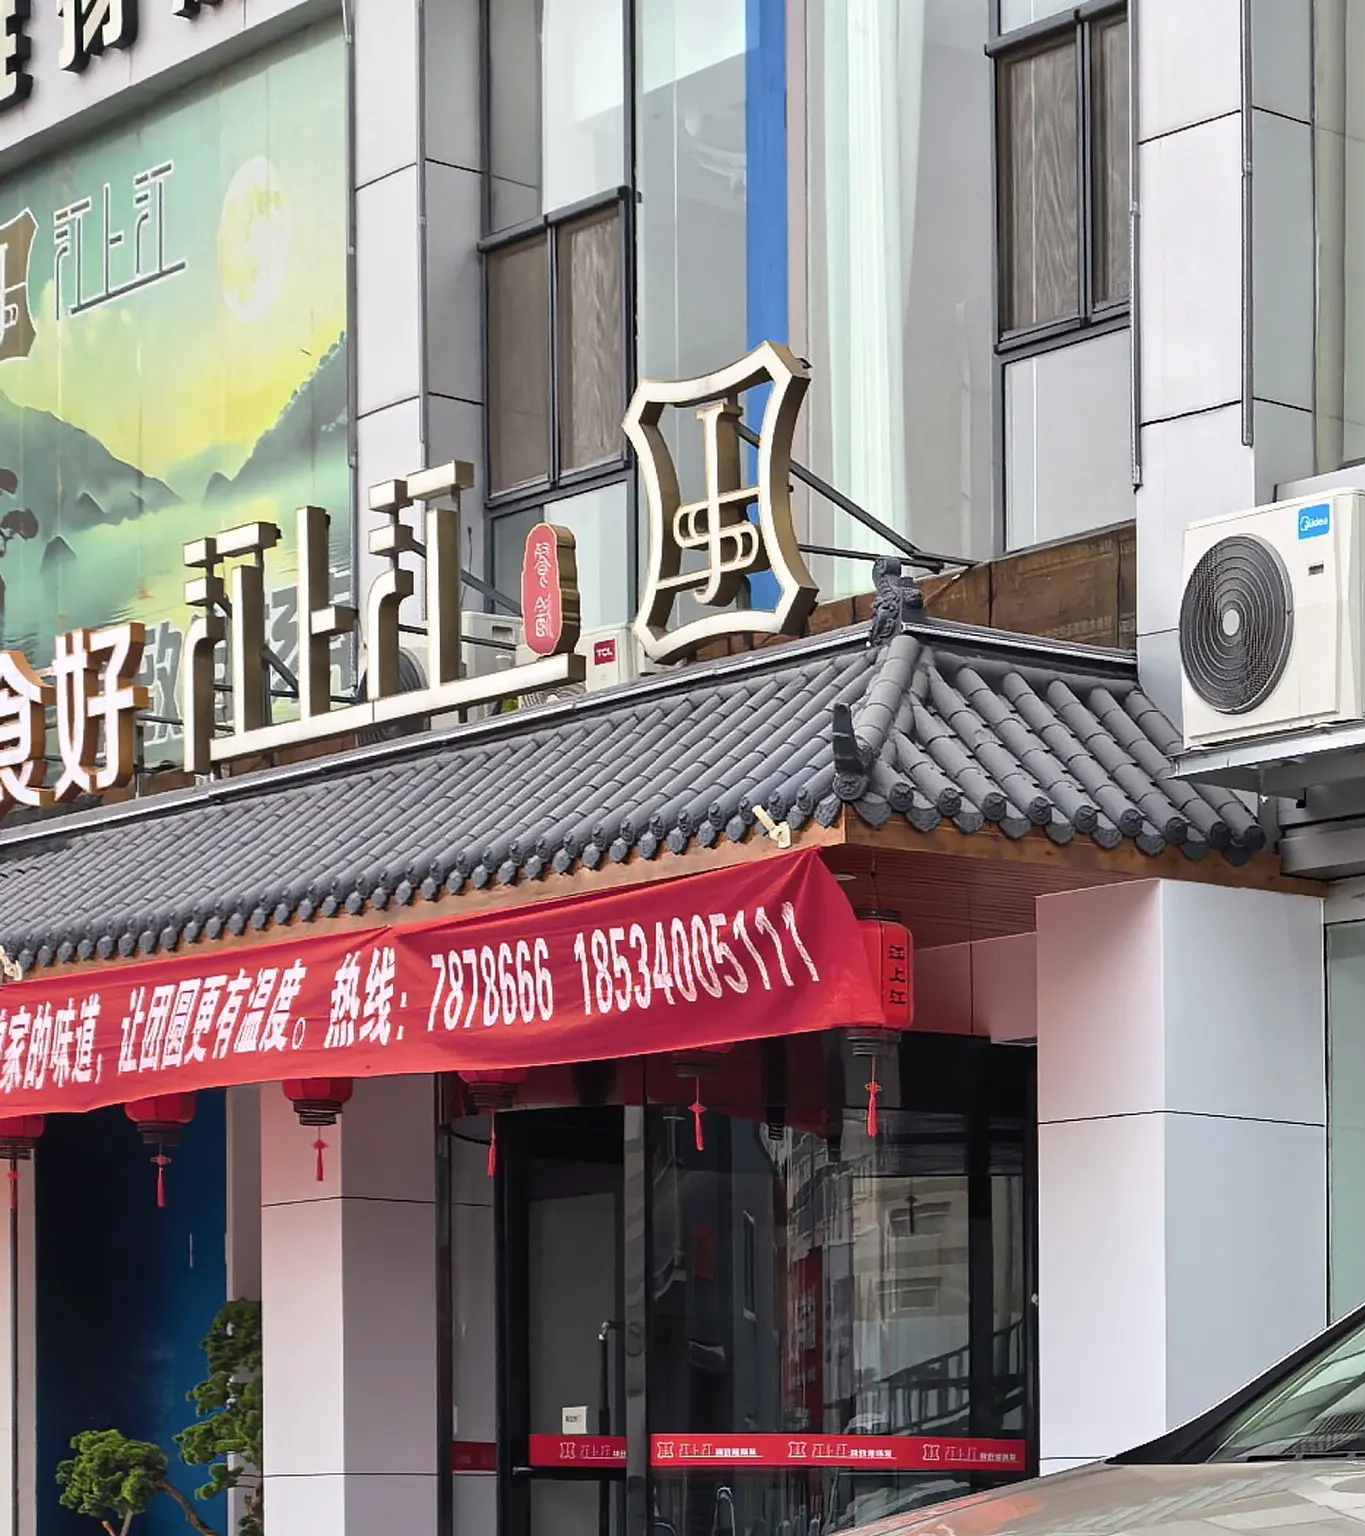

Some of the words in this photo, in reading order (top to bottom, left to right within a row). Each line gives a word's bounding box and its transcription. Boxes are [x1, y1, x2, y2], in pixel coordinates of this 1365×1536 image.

[596, 648, 613, 657] TCL
[426, 936, 554, 1032] 7878666
[573, 900, 820, 1017] 18534005111
